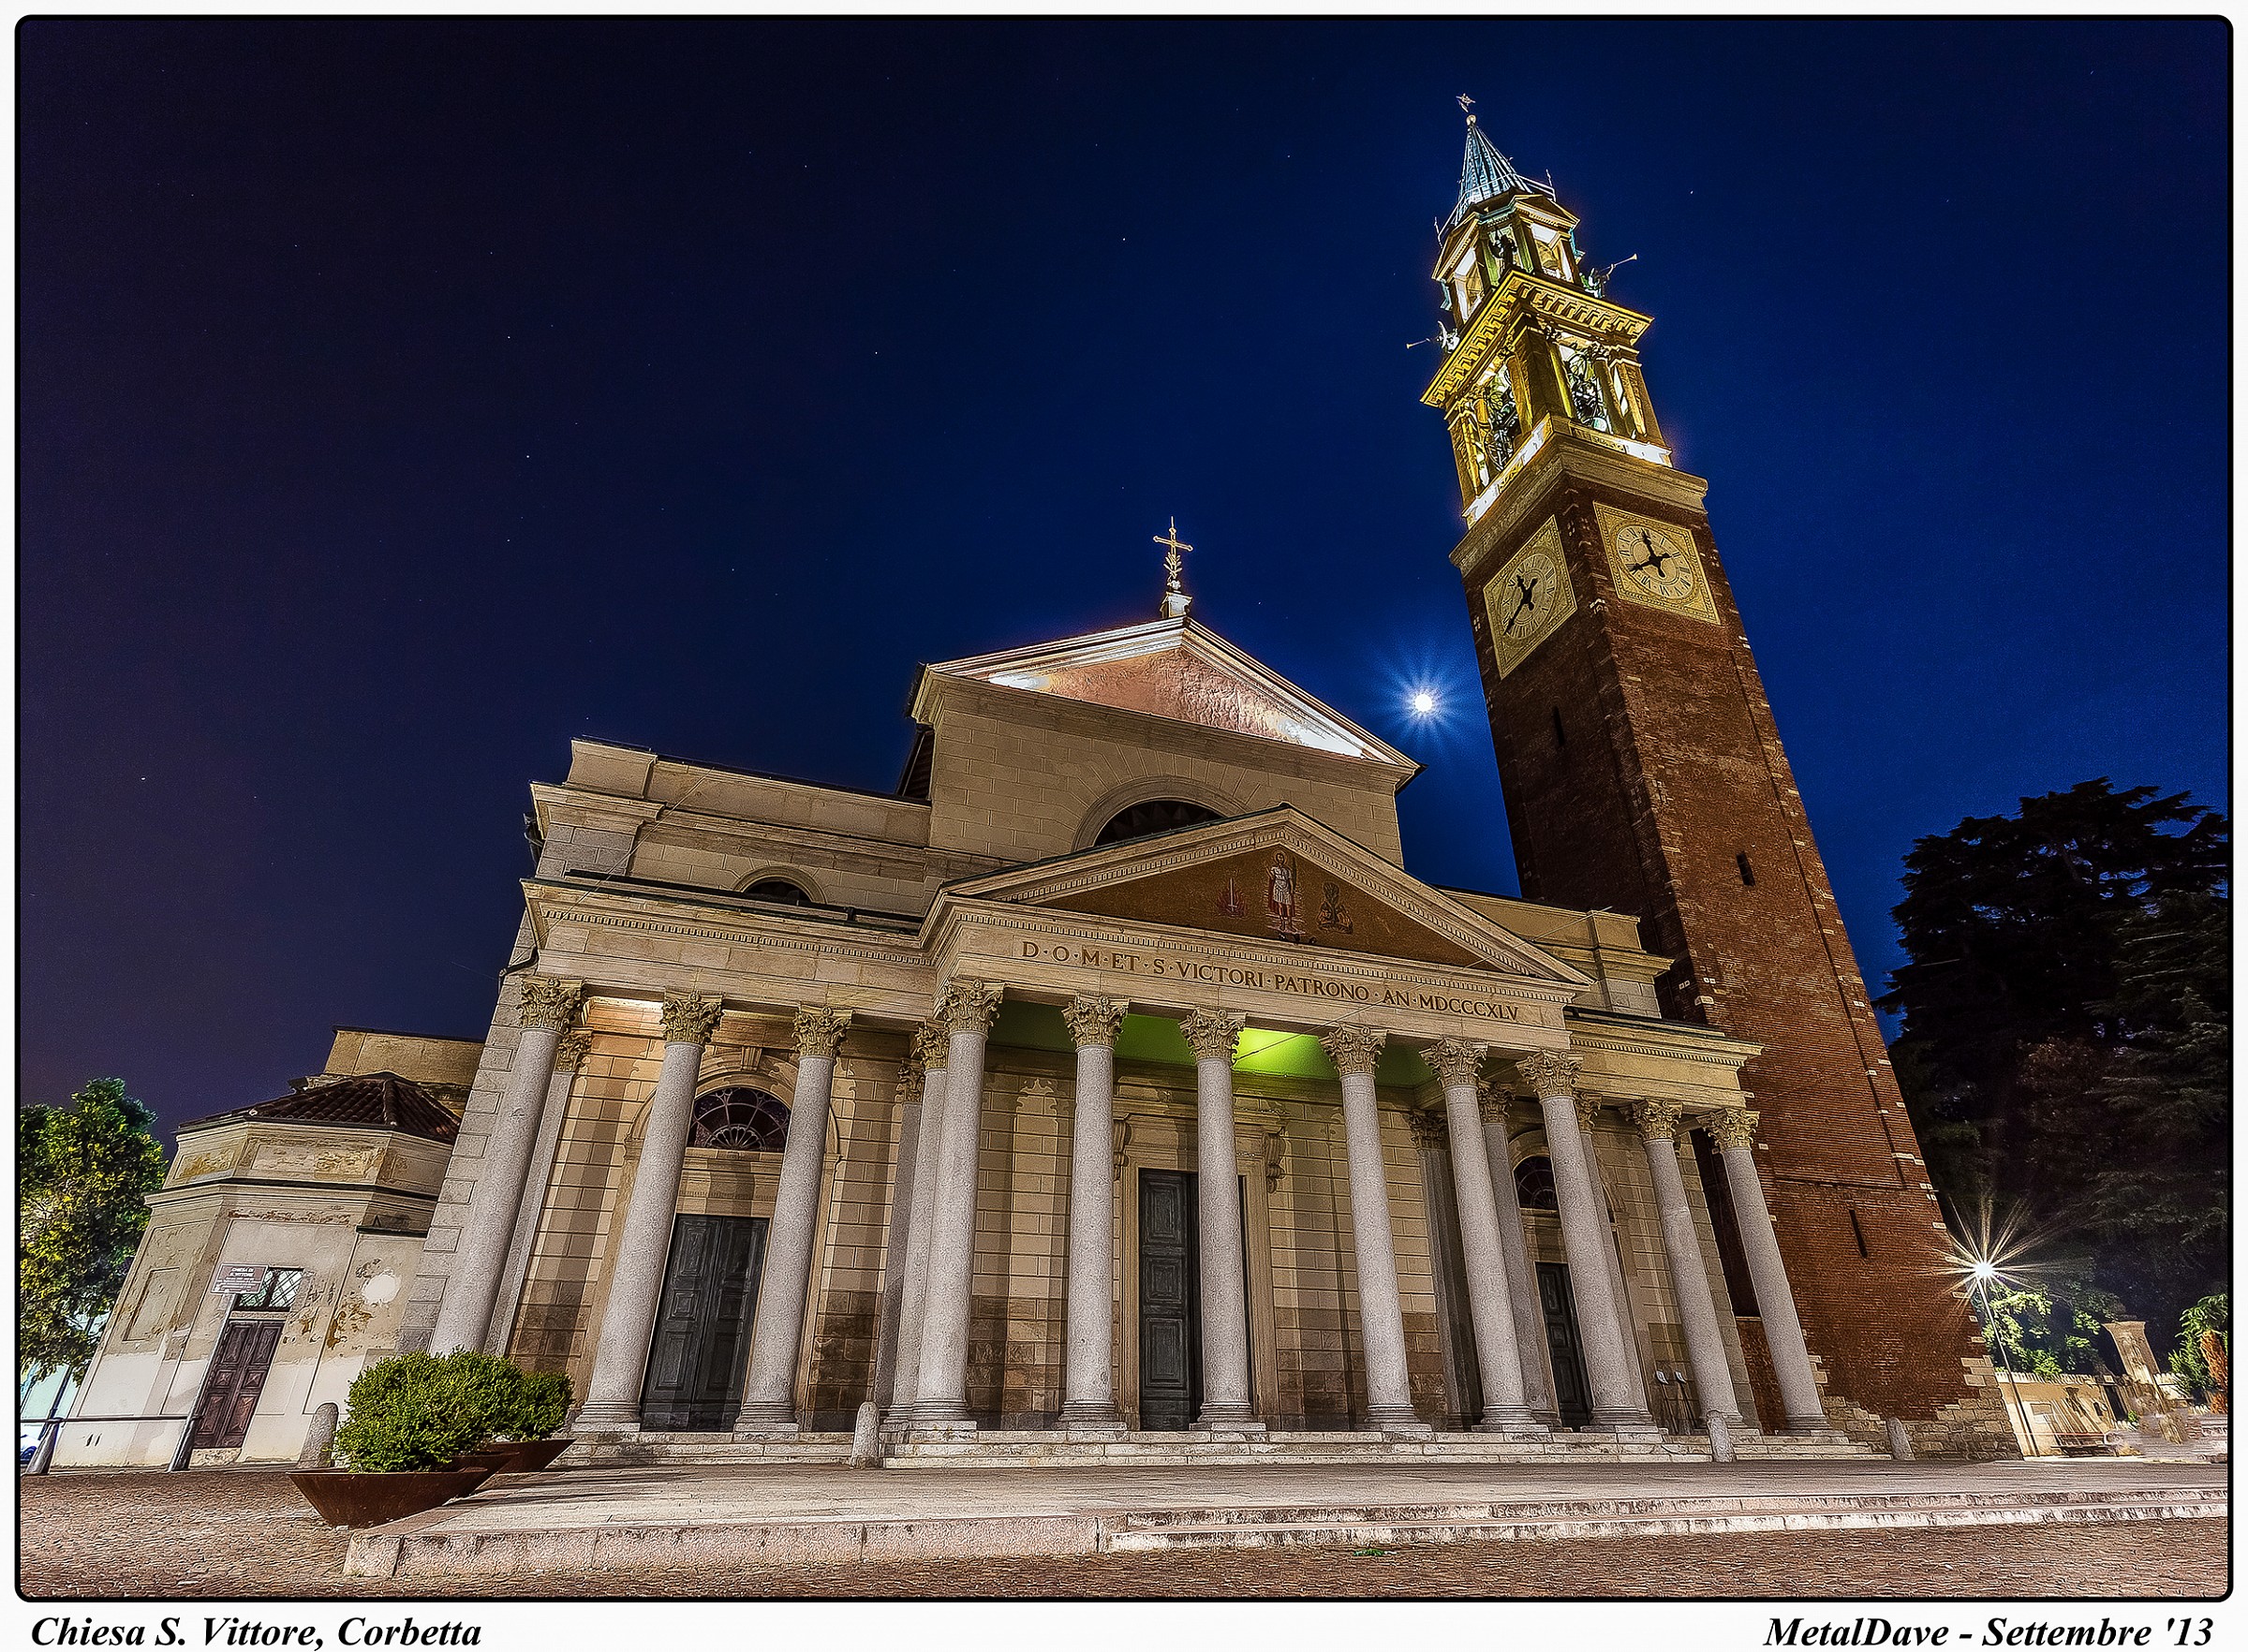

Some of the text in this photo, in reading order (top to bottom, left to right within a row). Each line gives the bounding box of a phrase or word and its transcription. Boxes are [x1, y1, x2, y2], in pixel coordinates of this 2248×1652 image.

[1176, 961, 1264, 988] VICTORI
[1274, 974, 1369, 1001] PATRONO
[1383, 989, 1411, 1007] AN
[1419, 993, 1519, 1021] MDCCCXLV
